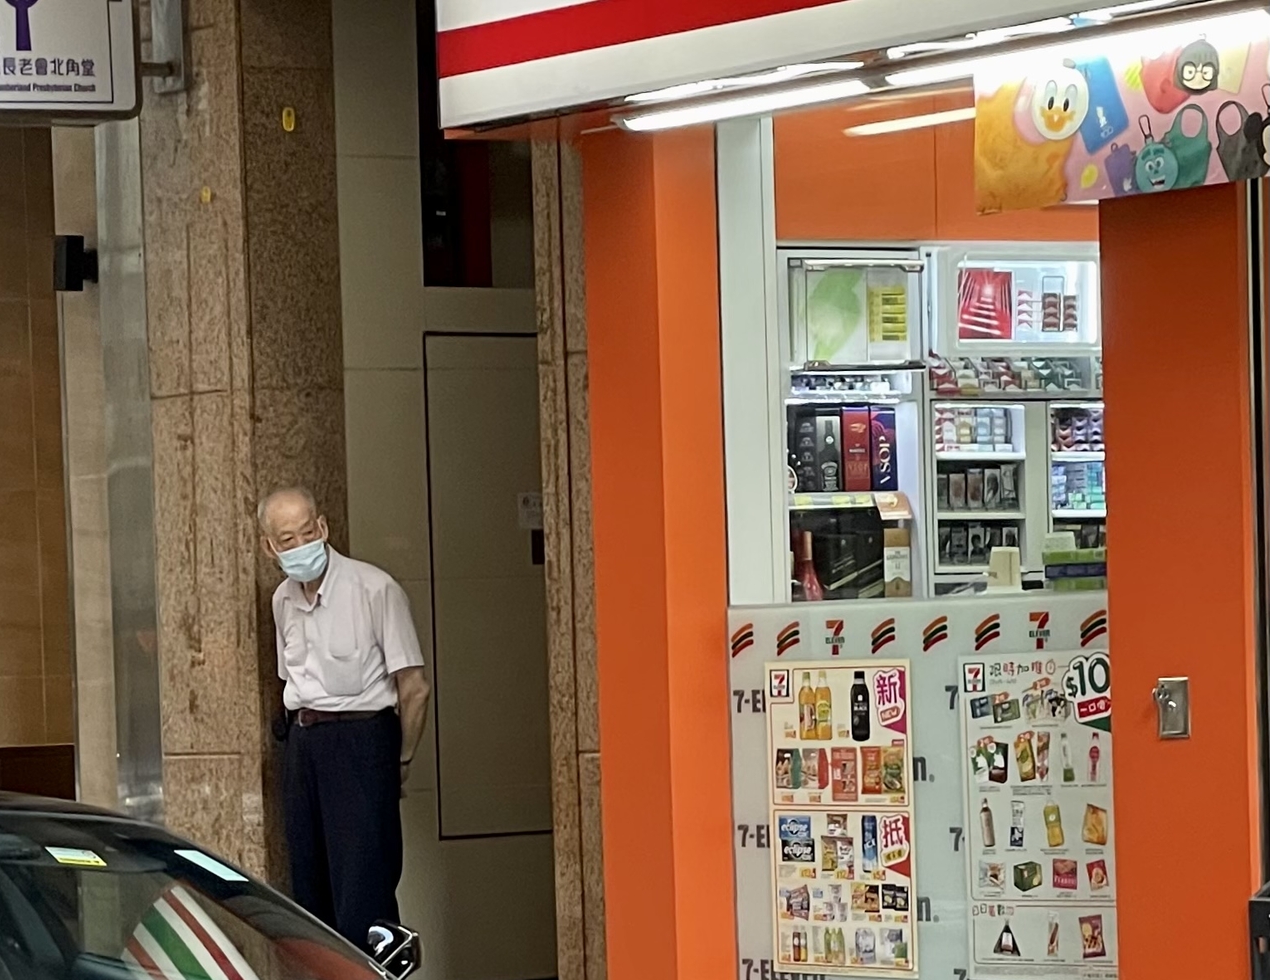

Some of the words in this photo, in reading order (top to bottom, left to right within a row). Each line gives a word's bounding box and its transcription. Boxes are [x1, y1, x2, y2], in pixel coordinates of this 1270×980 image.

[74, 84, 96, 92] Church
[876, 672, 898, 706] 新
[1066, 656, 1111, 698] $10
[881, 707, 900, 722] NEW
[883, 817, 903, 848] 抵
